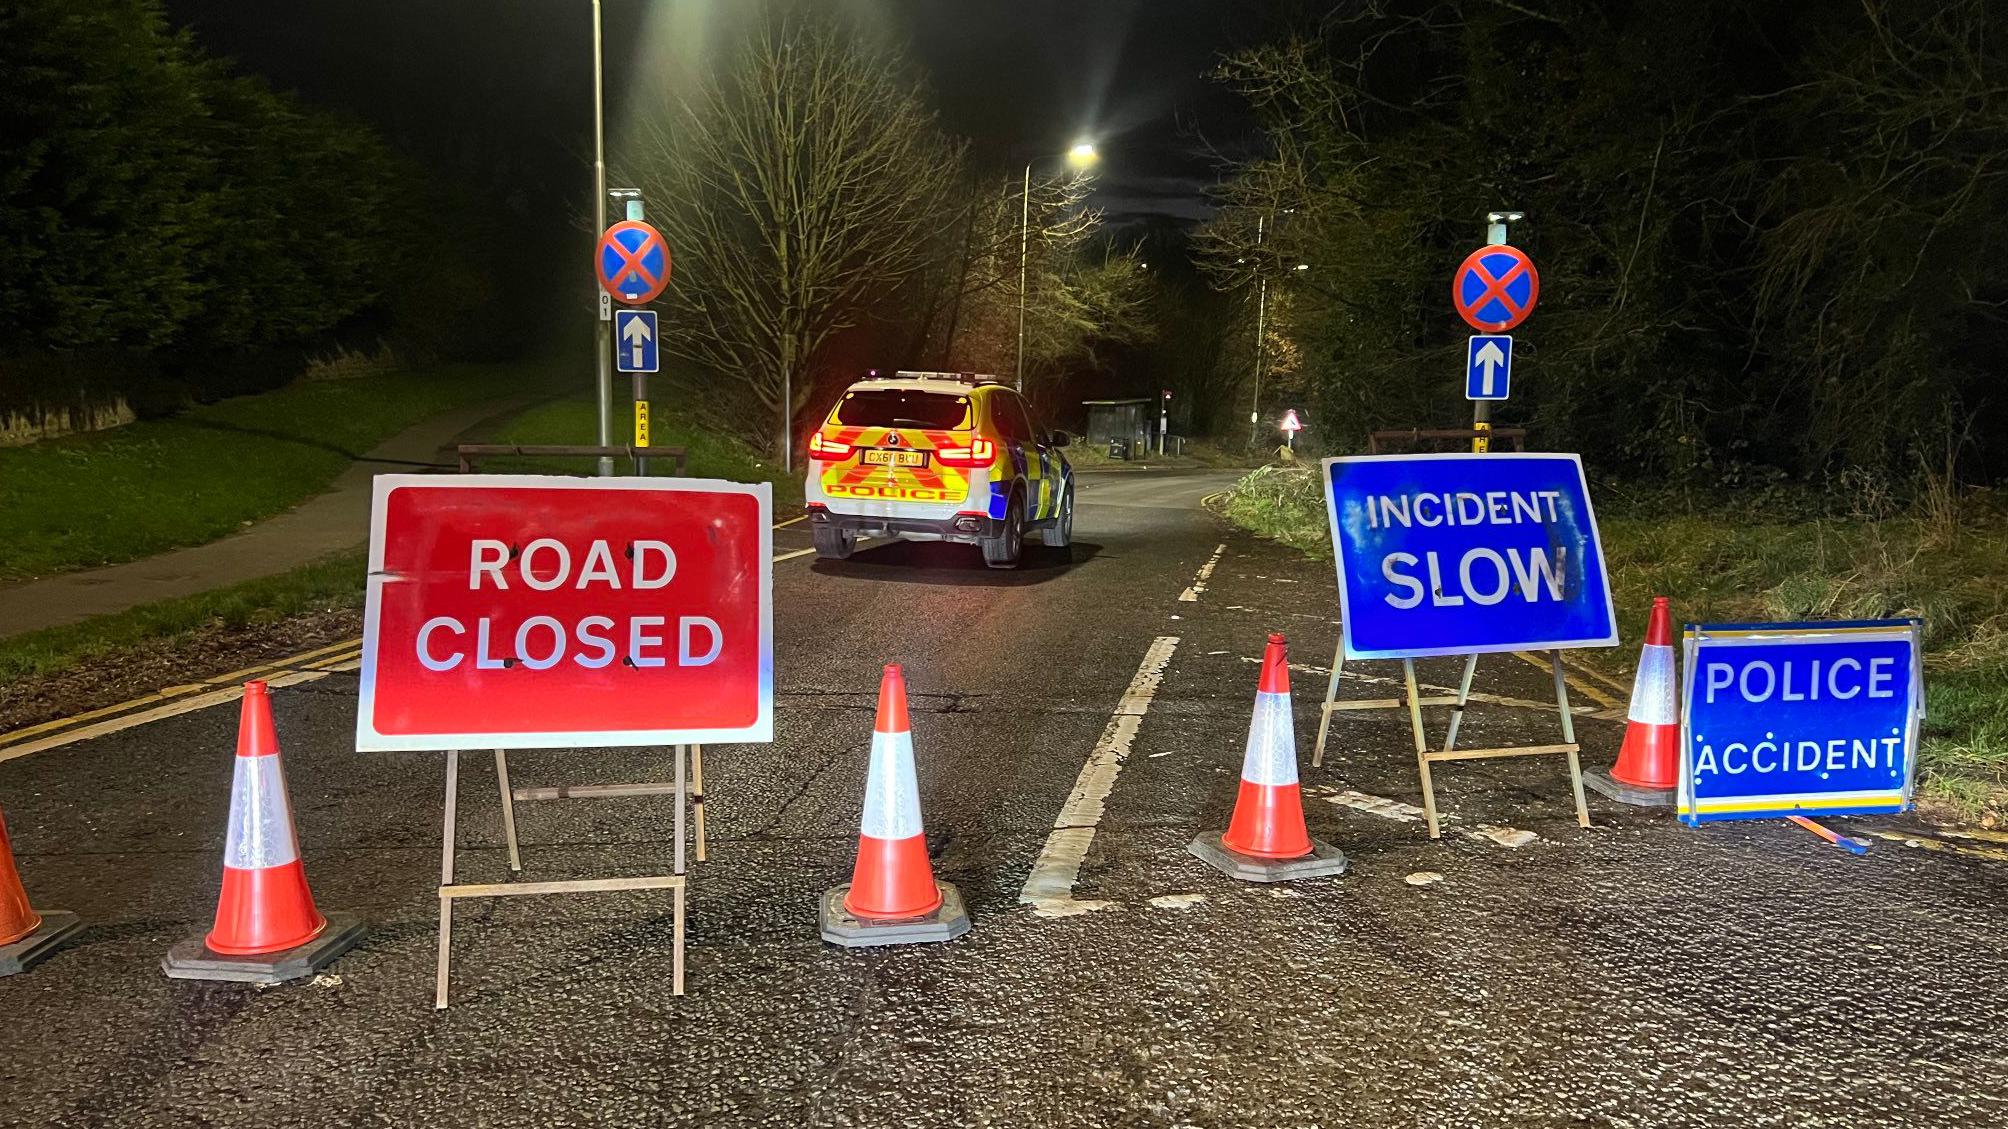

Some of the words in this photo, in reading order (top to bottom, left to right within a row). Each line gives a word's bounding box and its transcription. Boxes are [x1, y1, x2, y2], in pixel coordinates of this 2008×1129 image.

[826, 485, 960, 500] POLICE
[1367, 491, 1560, 529] INCIDENT
[469, 538, 677, 591] ROAD
[1381, 547, 1567, 609] SLOW
[416, 615, 723, 671] CLOSED
[1706, 657, 1895, 704] POLICE
[1694, 738, 1901, 775] ACCIDENT
